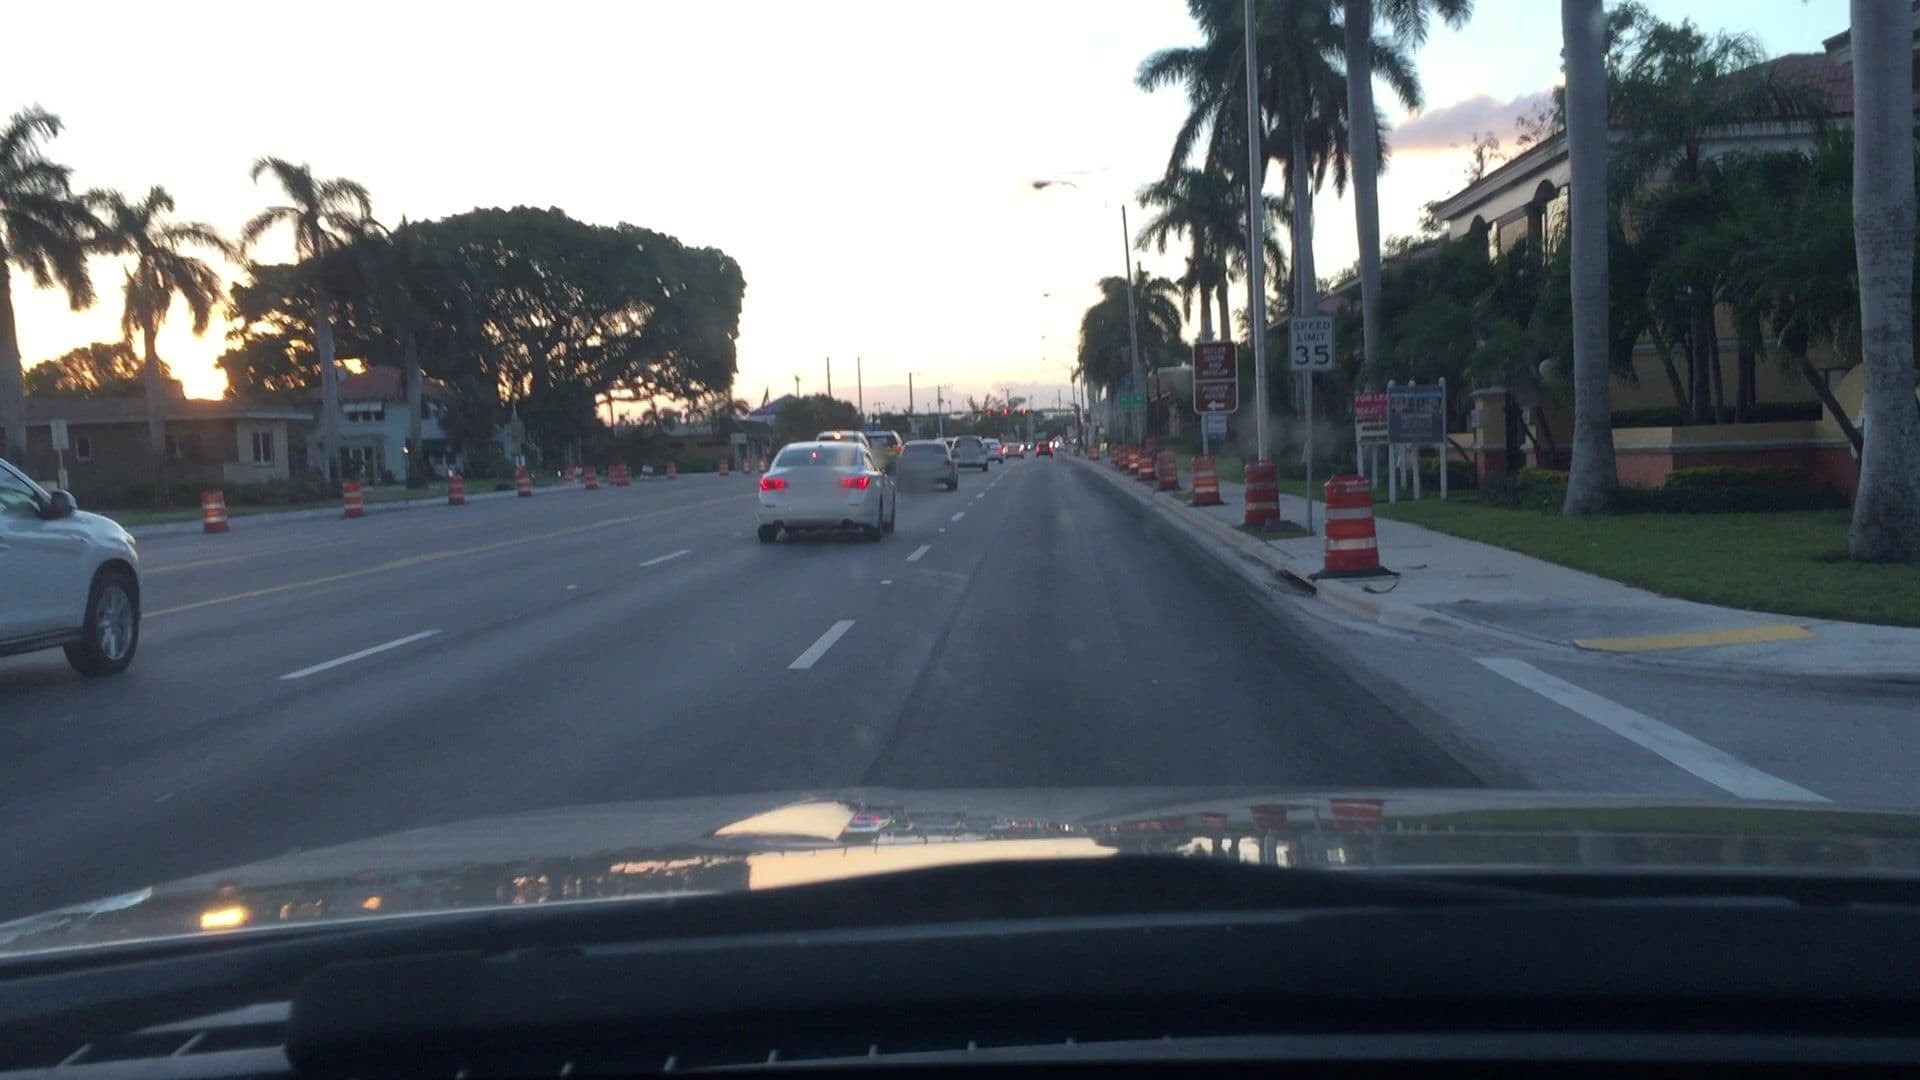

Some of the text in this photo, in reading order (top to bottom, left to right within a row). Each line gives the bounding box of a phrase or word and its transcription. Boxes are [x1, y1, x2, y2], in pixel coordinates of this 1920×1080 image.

[1294, 321, 1330, 330] SPEED
[1297, 333, 1325, 342] LIMIT
[1295, 345, 1330, 365] 35
[1355, 394, 1372, 402] FOR
